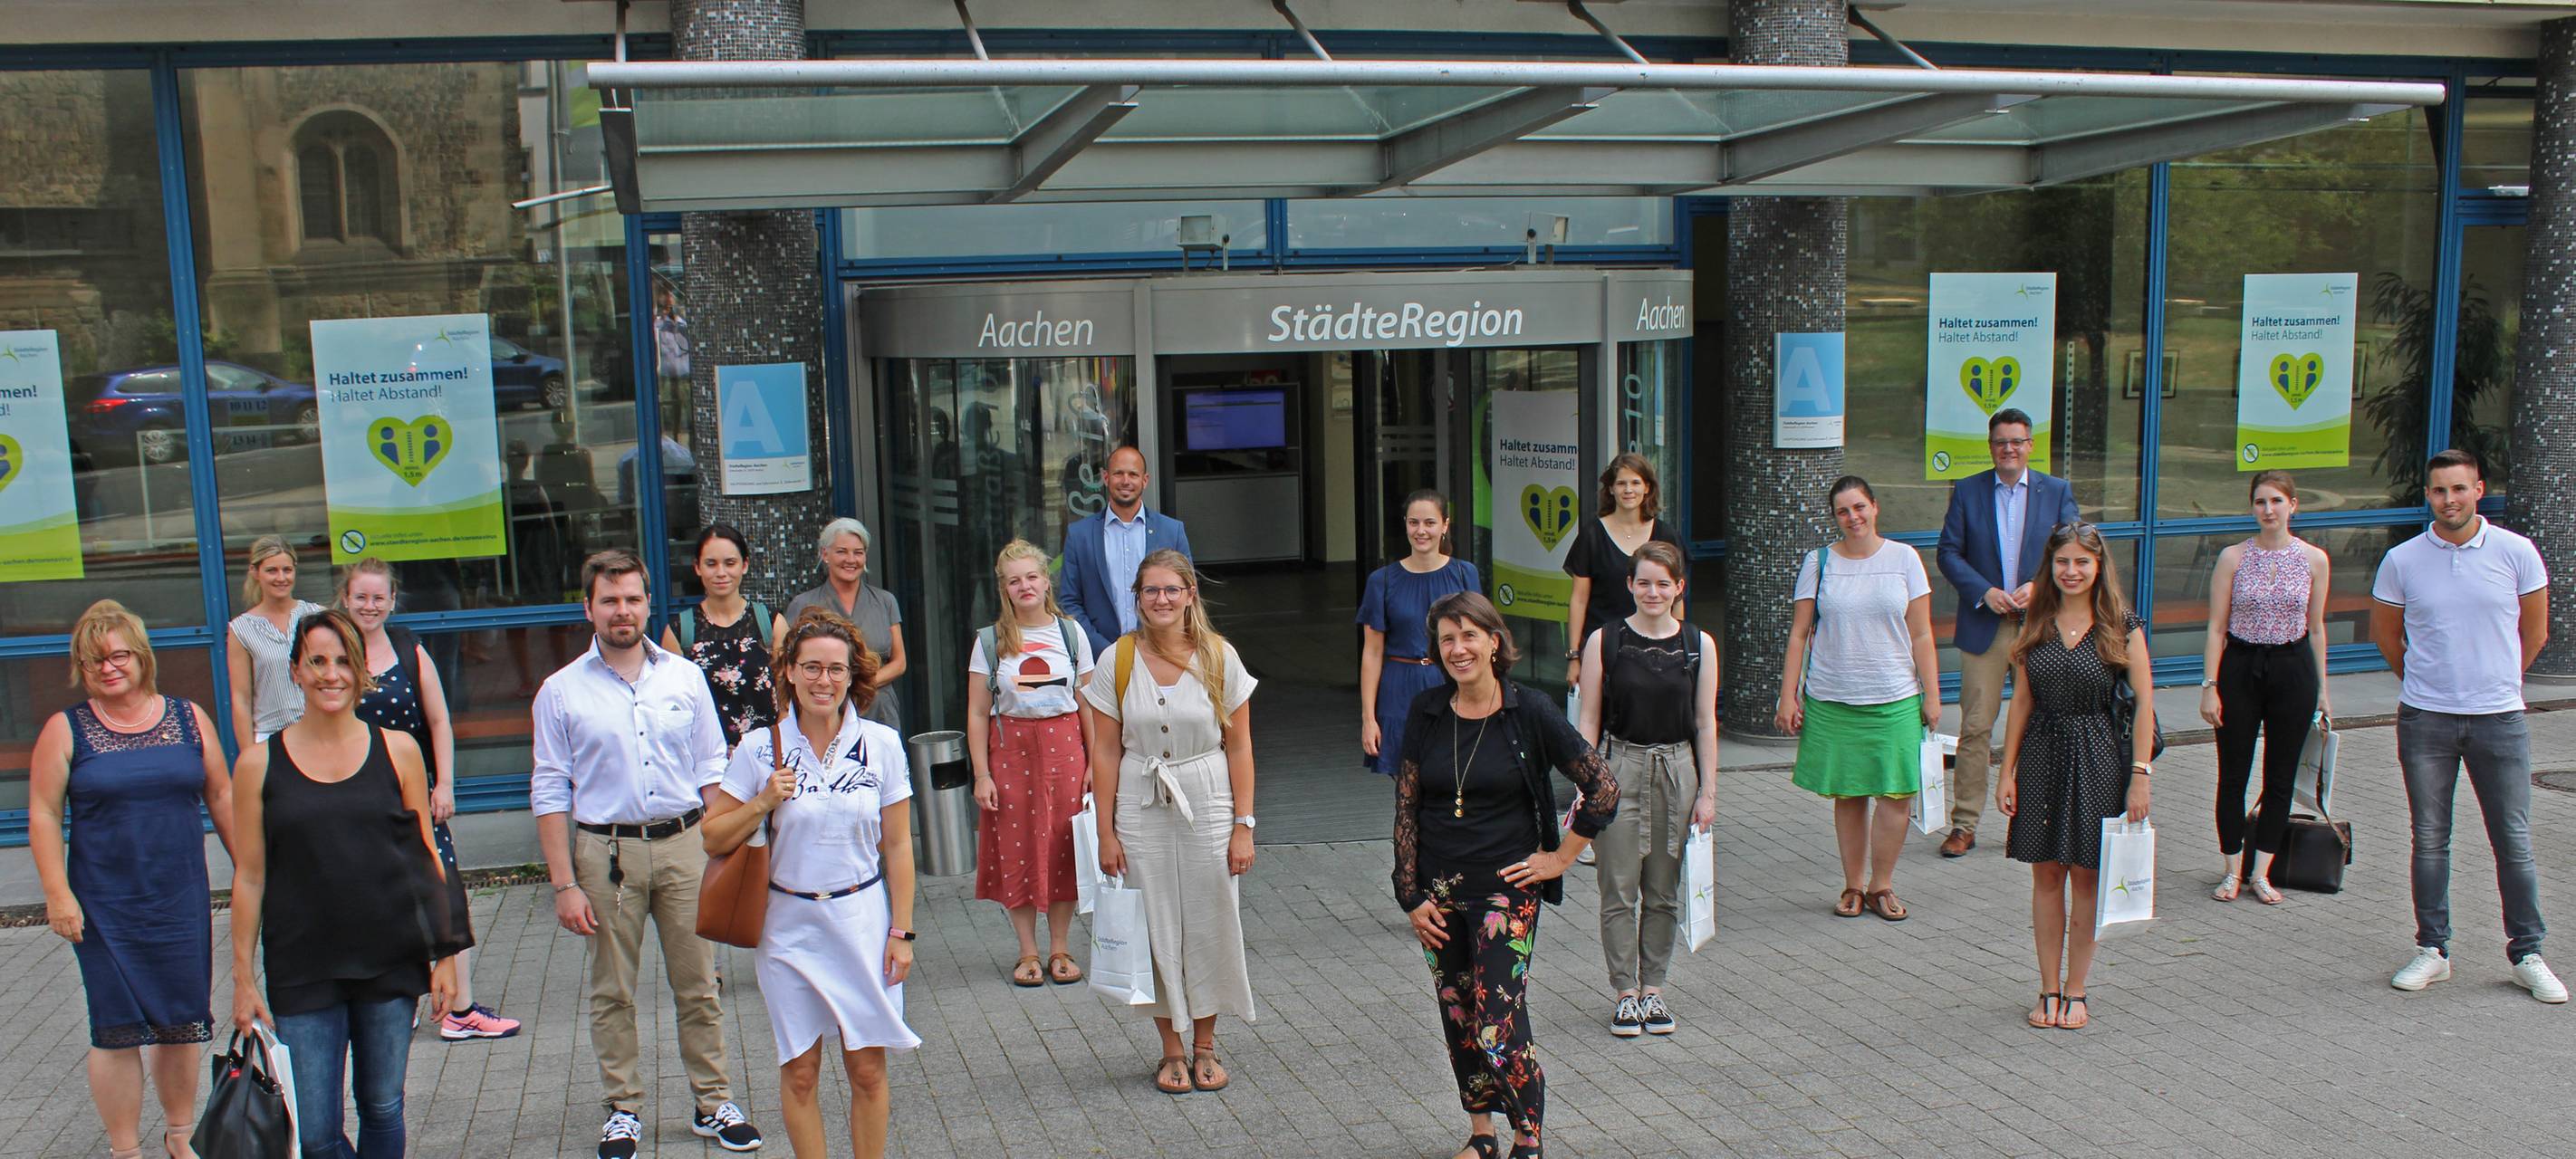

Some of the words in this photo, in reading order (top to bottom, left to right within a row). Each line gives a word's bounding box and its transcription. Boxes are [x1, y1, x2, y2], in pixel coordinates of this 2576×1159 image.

[977, 311, 1093, 348] Aachen
[1268, 301, 1523, 348] StädteRegion
[1636, 295, 1685, 331] Aachen
[1938, 318, 1973, 329] Haltet
[1975, 317, 2038, 328] zusammen!
[2252, 316, 2282, 327] Haltet
[2284, 315, 2341, 327] zusammen!
[1938, 332, 1970, 343] Haltet
[1972, 331, 2019, 343] Abstand!
[2251, 330, 2280, 341] Haltet
[2282, 330, 2323, 341] Abstand!
[330, 371, 377, 386] Haltet
[380, 367, 468, 383] zusammen!
[1779, 347, 1831, 413] A
[331, 388, 374, 403] Haltet
[378, 385, 442, 400] Abstand!
[722, 380, 784, 455] A
[1500, 439, 1531, 452] Haltet
[1533, 444, 1578, 455] zusamm
[1500, 455, 1529, 468] Haltet
[1531, 456, 1575, 471] Abstand!
